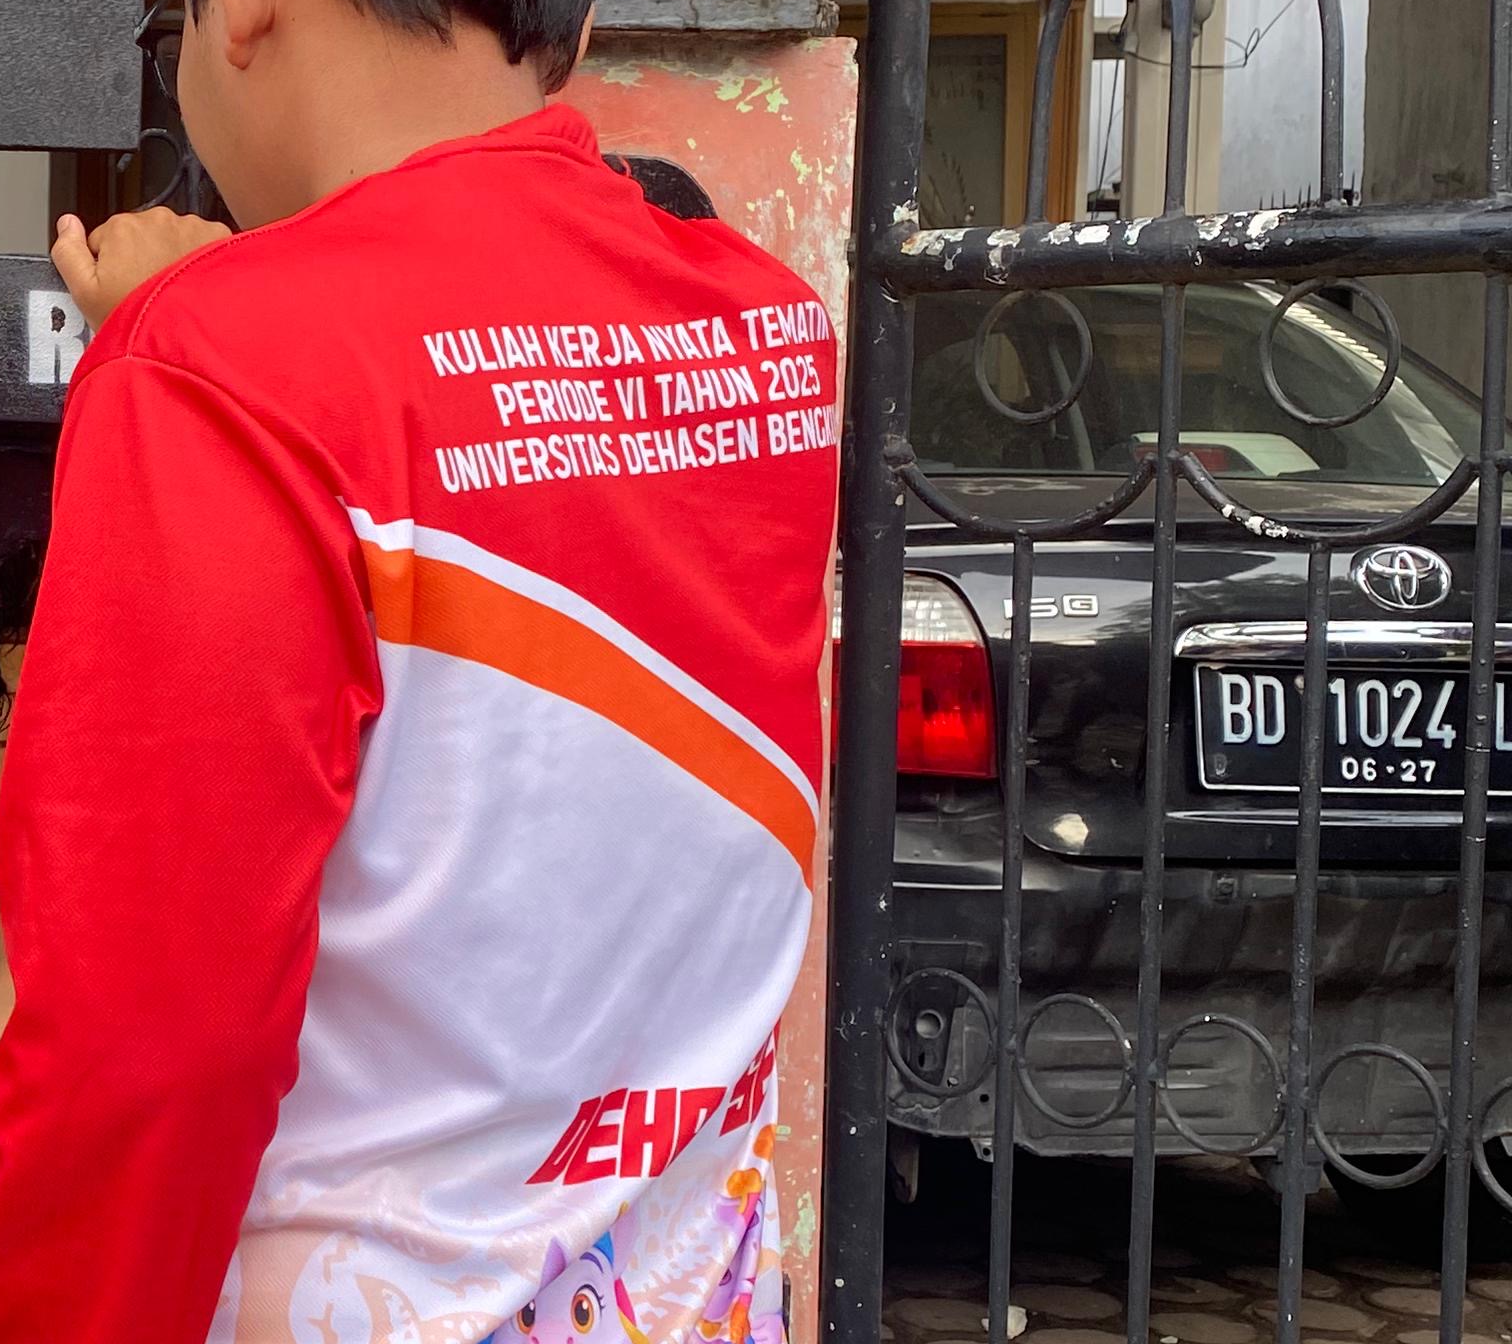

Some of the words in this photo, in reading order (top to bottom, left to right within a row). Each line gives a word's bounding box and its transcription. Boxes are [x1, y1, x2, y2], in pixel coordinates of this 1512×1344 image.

[28, 289, 96, 384] R
[423, 325, 547, 377] KULIAH
[542, 324, 644, 368] KERJA
[639, 315, 737, 362] NYATA
[491, 378, 613, 426] PERIODE
[614, 376, 647, 421] VI
[654, 366, 760, 417] TAHUN
[760, 354, 821, 402] 2025
[435, 433, 621, 494] UNIVERSITAS
[619, 416, 759, 475] DEHASEN
[1220, 673, 1286, 745] BD
[1329, 677, 1457, 750] 1024
